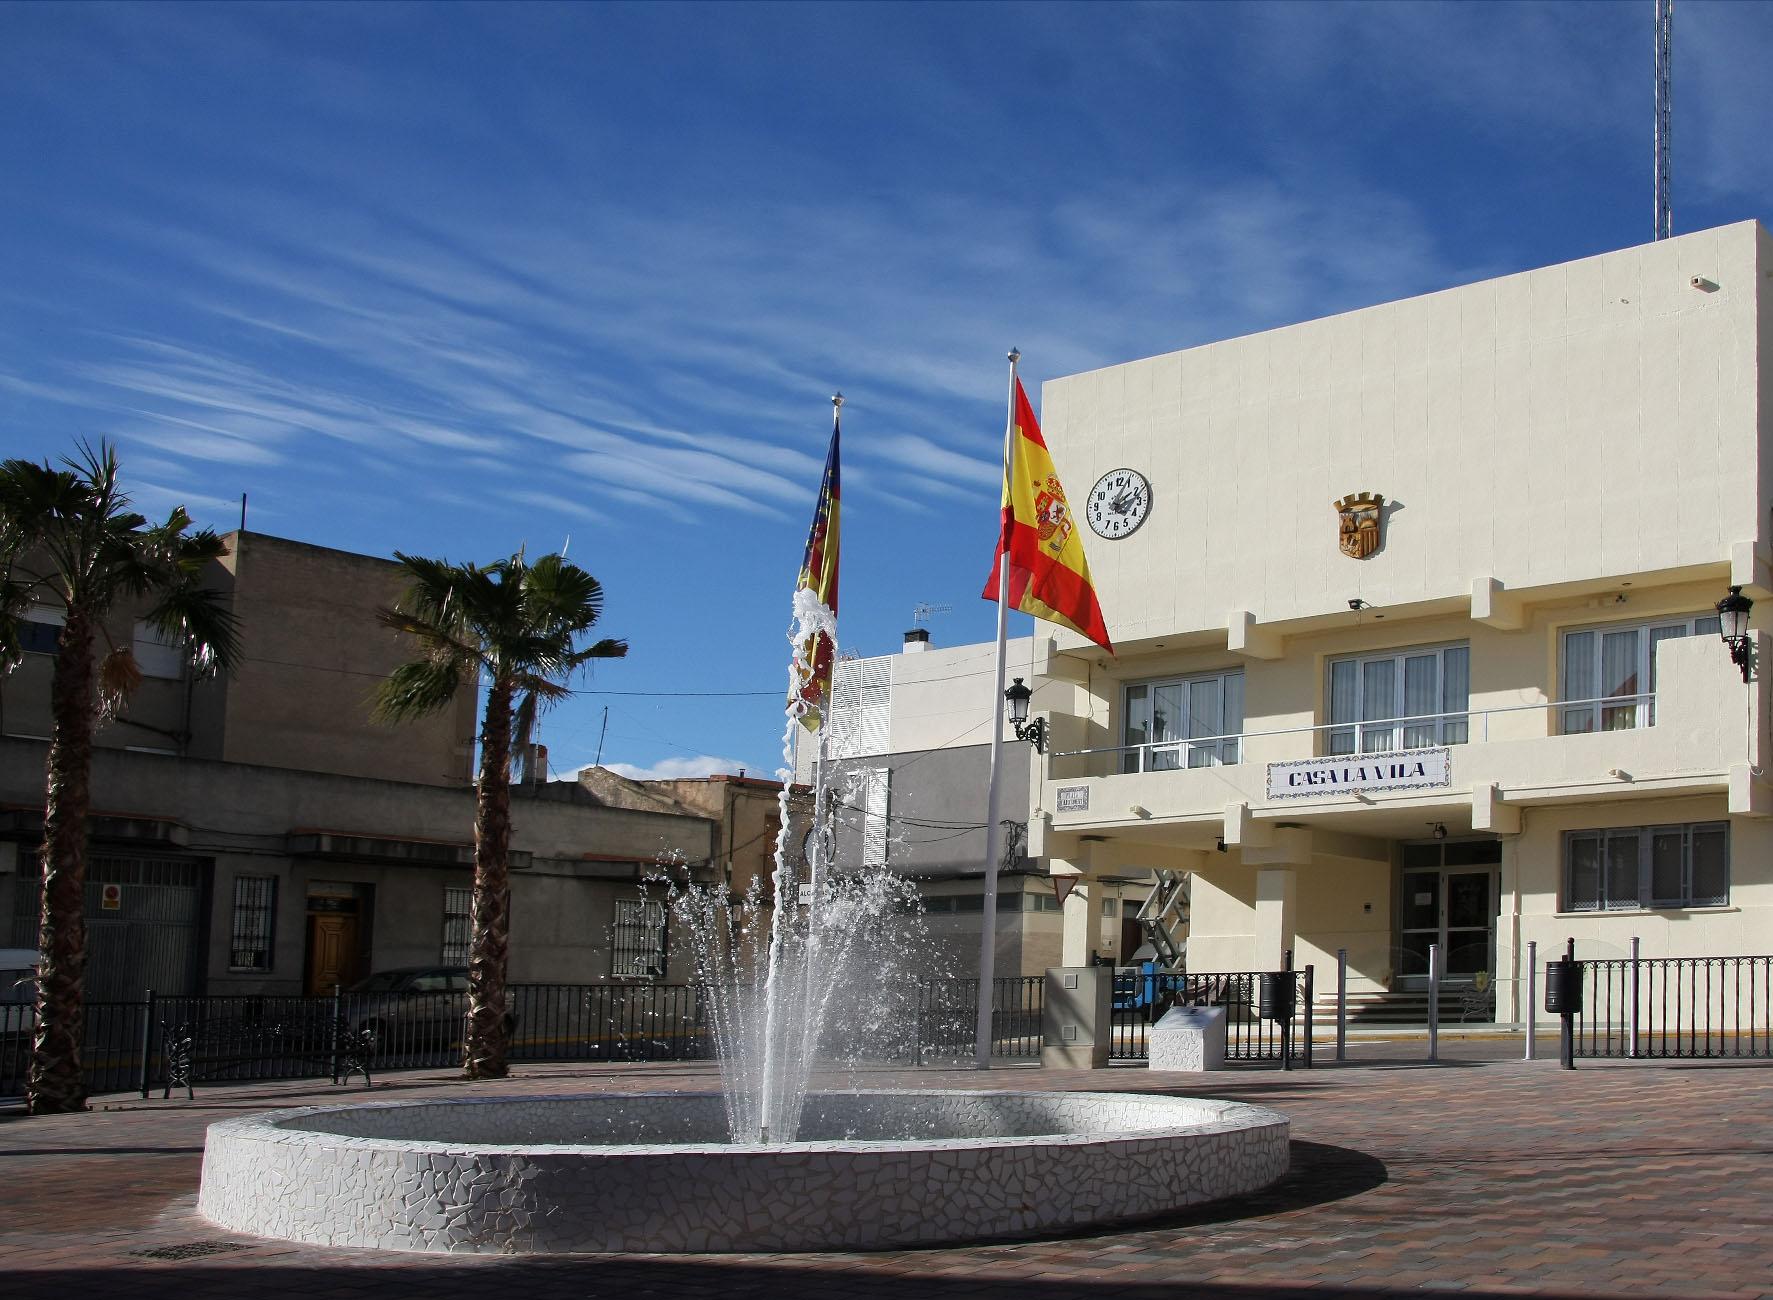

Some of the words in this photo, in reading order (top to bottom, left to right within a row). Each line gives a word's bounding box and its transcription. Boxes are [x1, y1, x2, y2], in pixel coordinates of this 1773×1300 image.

[1108, 482, 1113, 490] 11
[1116, 477, 1124, 487] 12
[1133, 487, 1139, 496] 2
[1098, 492, 1105, 501] 10
[1137, 497, 1142, 506] 3
[1094, 503, 1099, 511] 9
[1096, 512, 1102, 521] 8
[1132, 508, 1137, 516] 4
[1105, 520, 1110, 529] 7
[1114, 522, 1119, 530] 6
[1123, 518, 1128, 527] 5
[1289, 769, 1338, 787] CASA
[1343, 767, 1367, 783] LA
[1374, 762, 1425, 780] VILA
